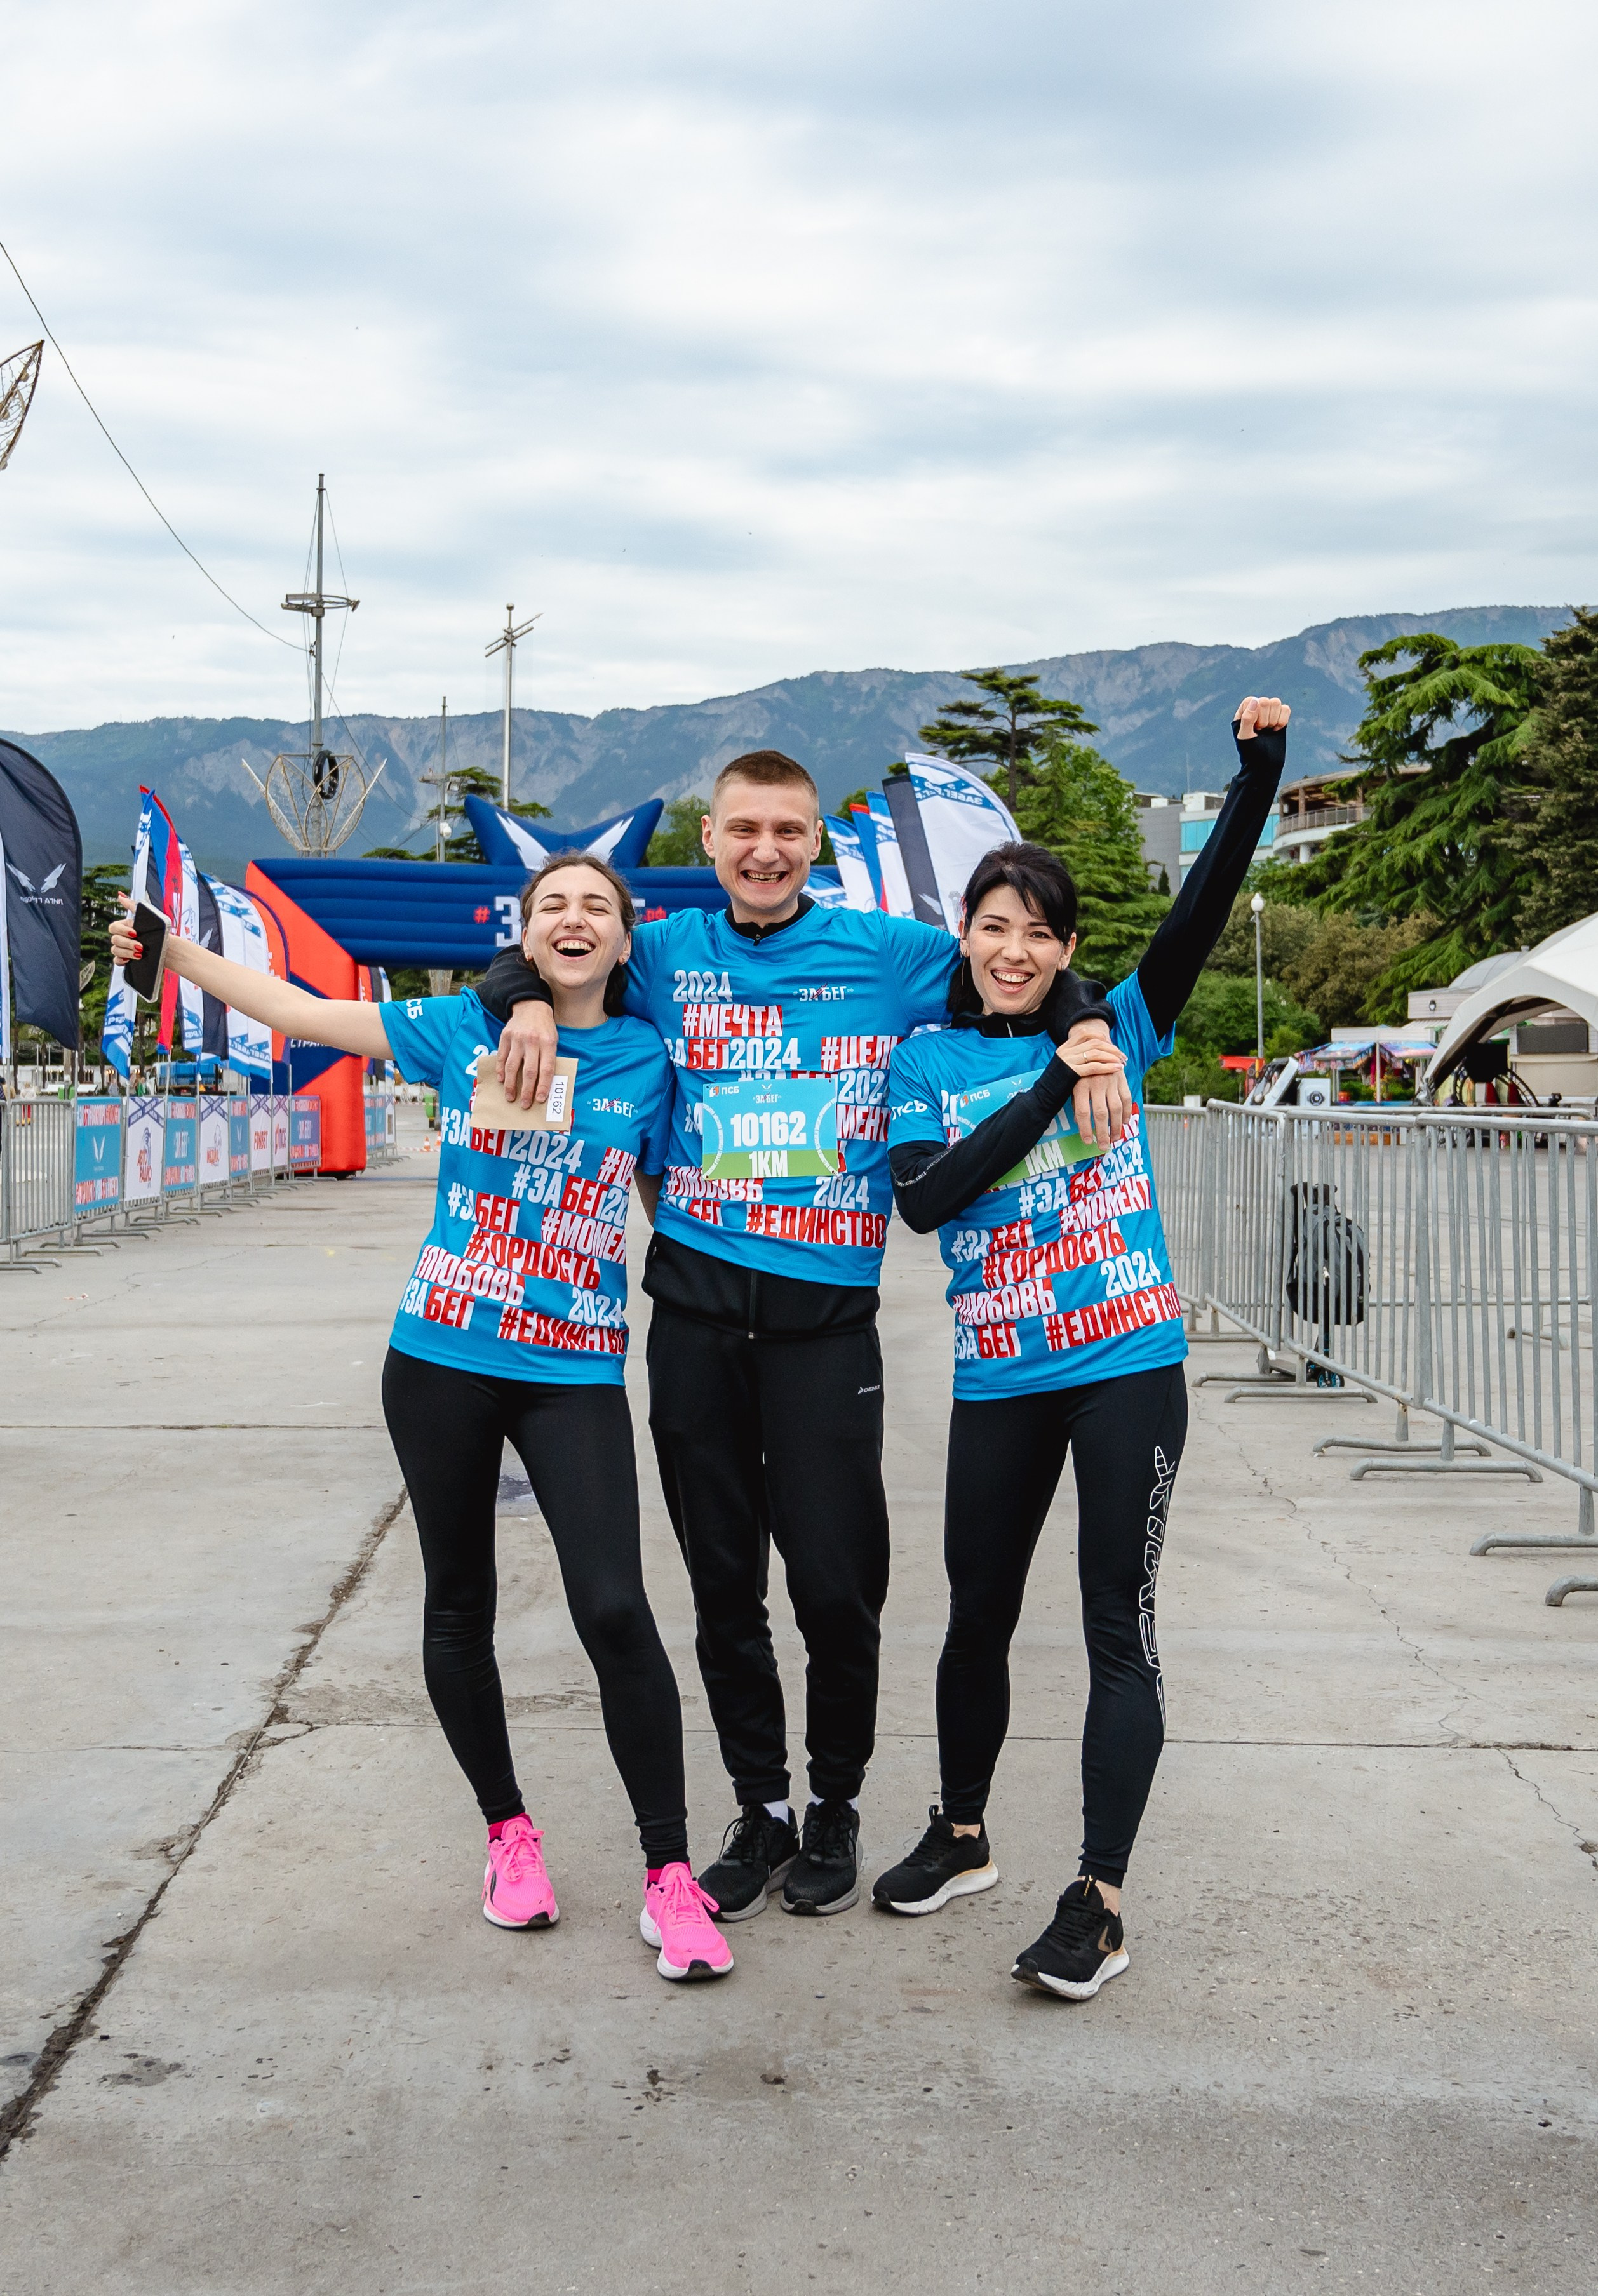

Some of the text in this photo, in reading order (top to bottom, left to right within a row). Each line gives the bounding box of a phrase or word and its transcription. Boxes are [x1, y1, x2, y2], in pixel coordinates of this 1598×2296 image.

[673, 970, 733, 1003] 2024
[406, 999, 424, 1020] СБ
[683, 1004, 783, 1037] #МЕЧТА
[551, 1081, 565, 1116] 10162
[721, 1086, 740, 1095] ПСБ
[970, 1089, 990, 1103] ПСБ
[730, 1111, 807, 1147] 10162
[836, 1104, 890, 1142] МЕНТ
[814, 1176, 869, 1210] 2024
[1059, 1173, 1153, 1236] #МОМЕНТ
[745, 1204, 887, 1248] #ЕДИНСТВО
[951, 1218, 1036, 1263] #ЗАБЕГ
[981, 1219, 1128, 1289] #ГОРДОСТЬ
[1100, 1248, 1162, 1298] 2024
[415, 1245, 526, 1307] #ЛЮБОВЬ
[568, 1287, 624, 1329] 2024
[952, 1276, 1058, 1325] #ЛЮБОВЬ
[1042, 1281, 1182, 1352] #ЕДИНСТВО
